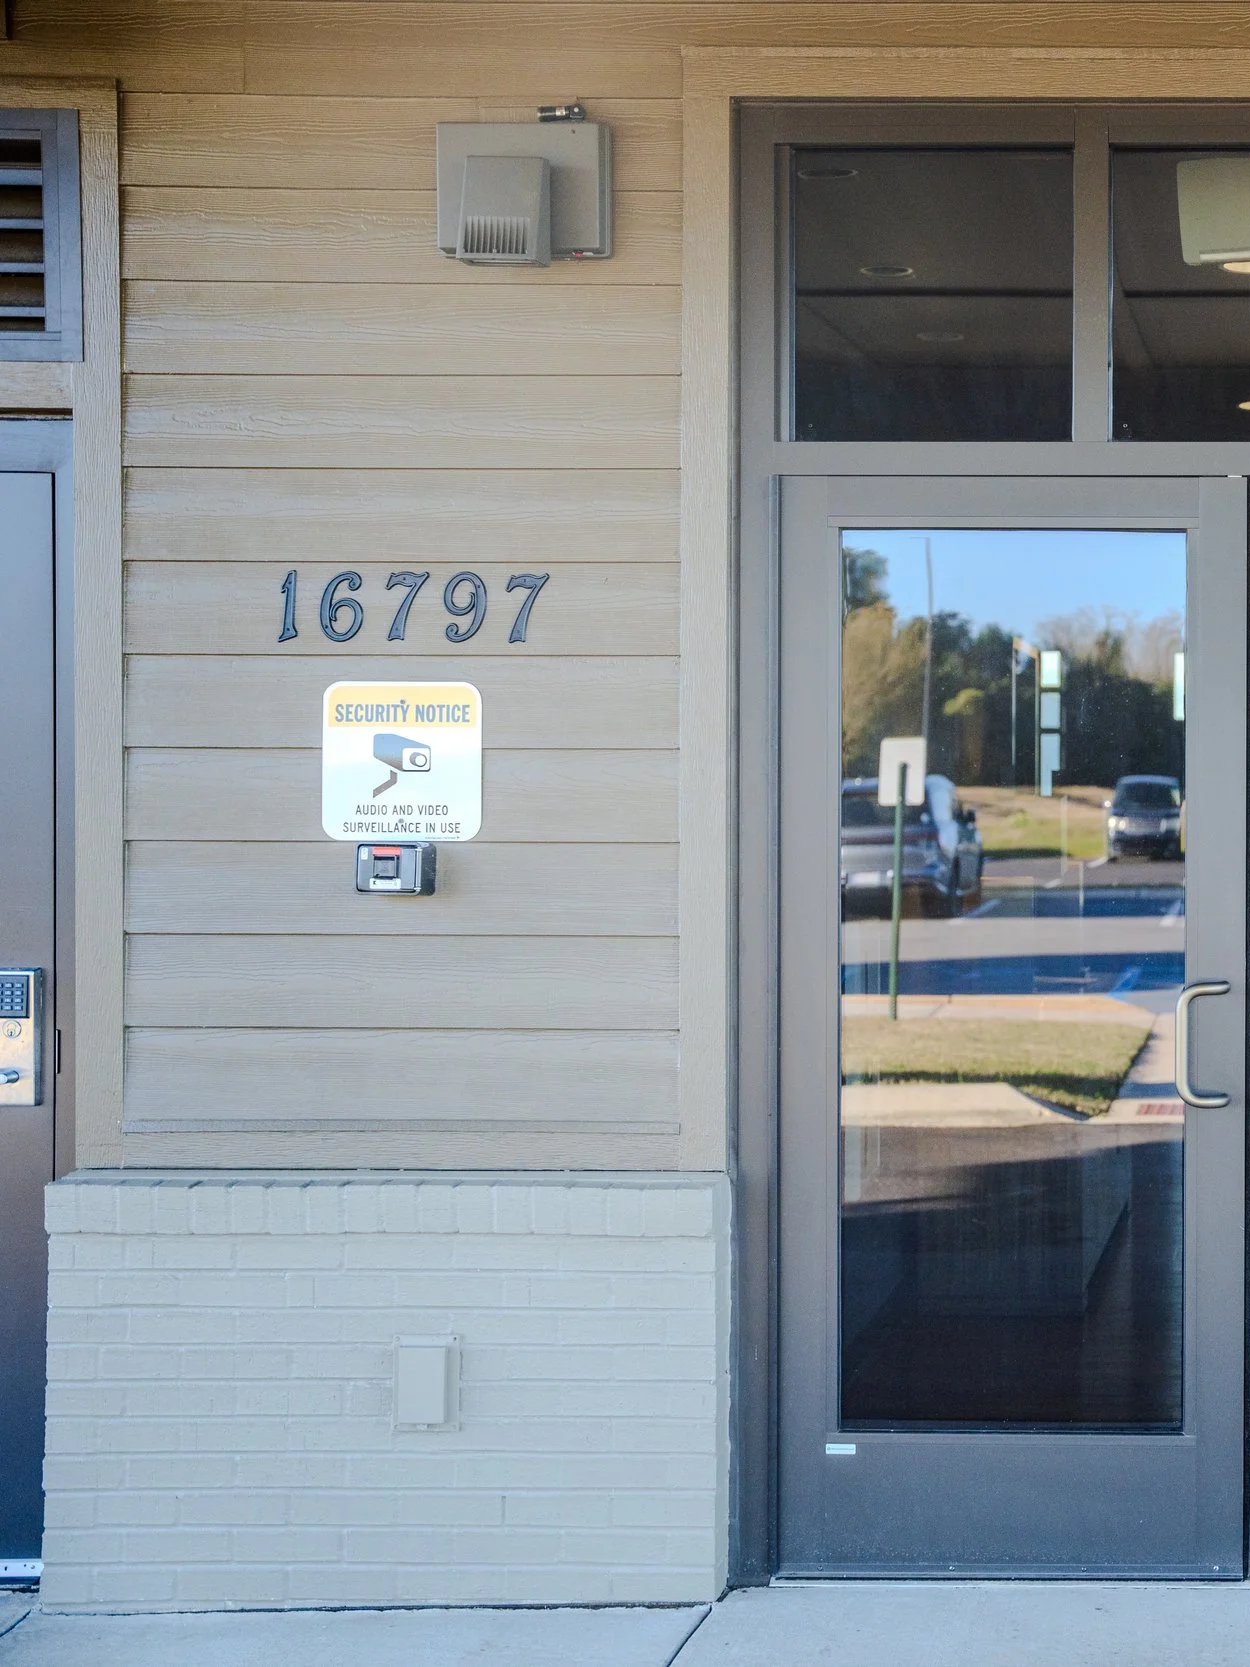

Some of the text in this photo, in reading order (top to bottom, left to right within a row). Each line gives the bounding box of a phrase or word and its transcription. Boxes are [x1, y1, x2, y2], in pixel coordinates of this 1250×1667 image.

[278, 570, 549, 643] 16797
[335, 704, 470, 723] SECURITY NOTICE
[355, 805, 449, 816] AUDIO AND VIDEO
[343, 822, 461, 834] SURVEILLANCE IN USE
